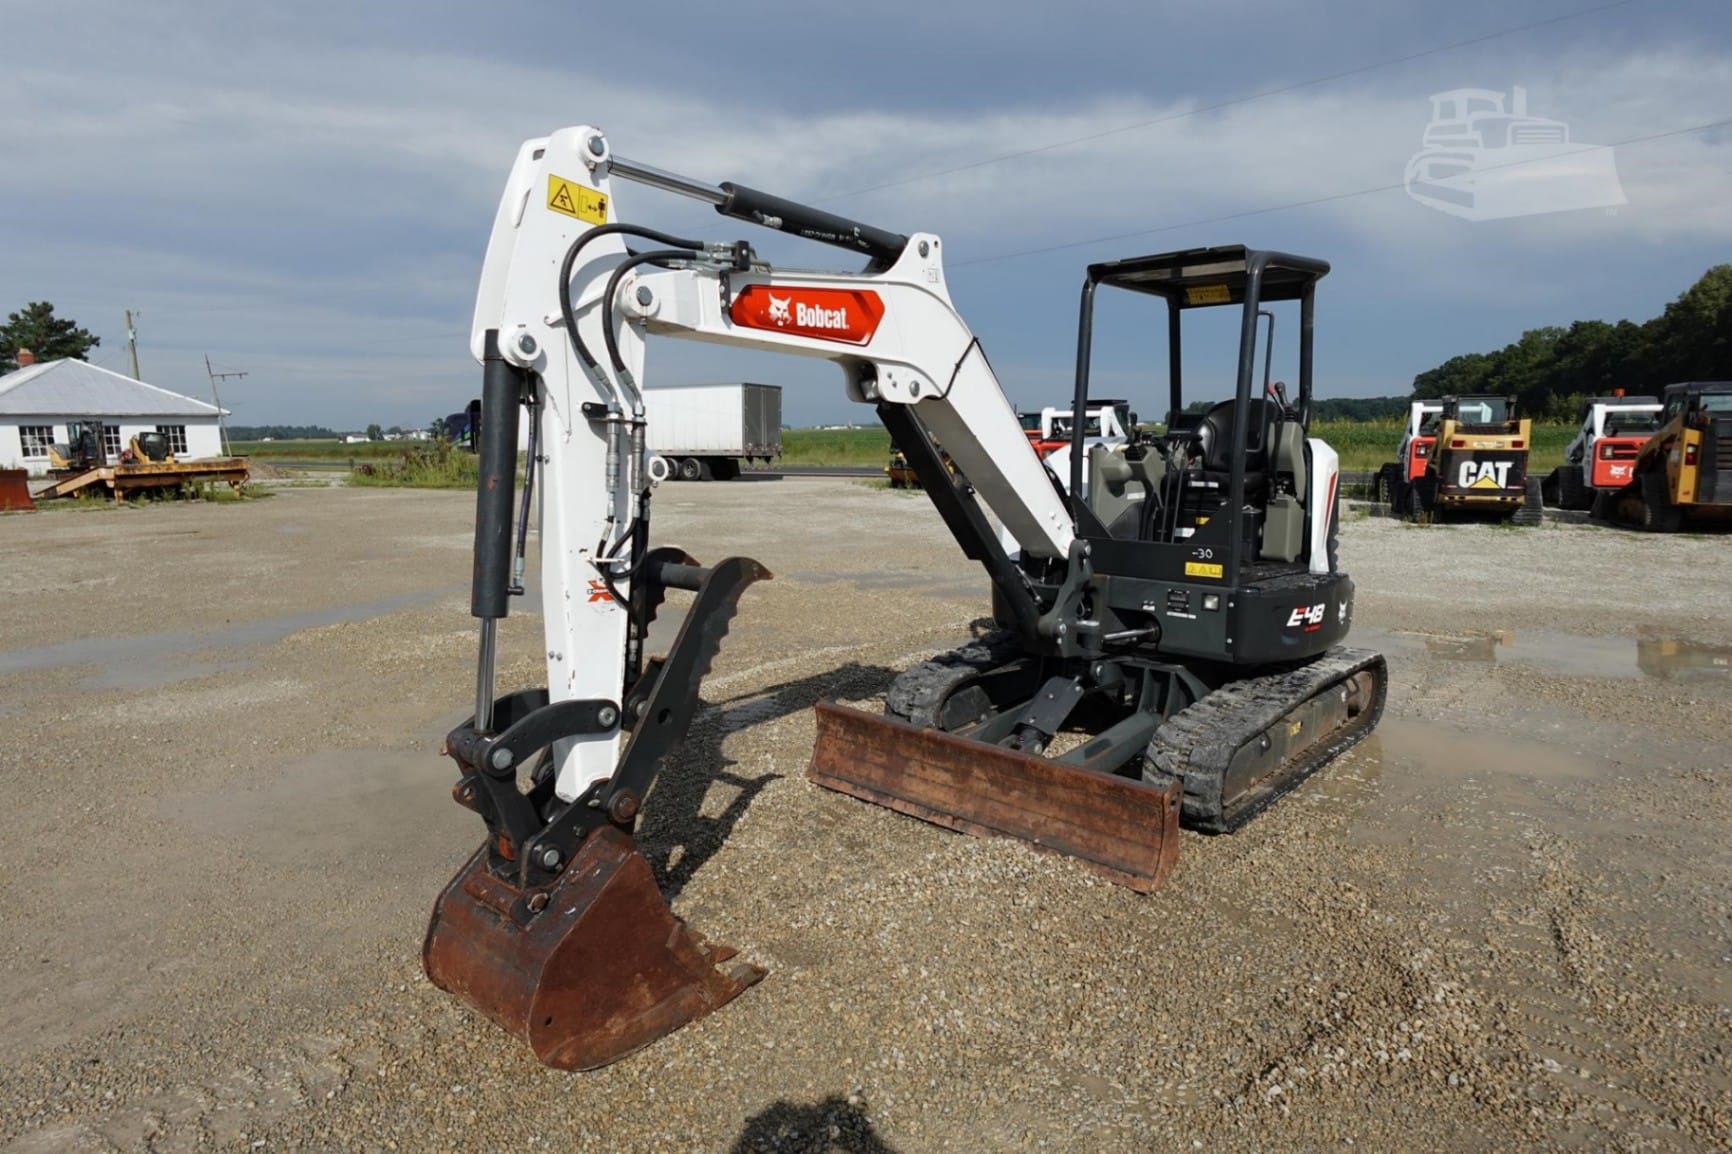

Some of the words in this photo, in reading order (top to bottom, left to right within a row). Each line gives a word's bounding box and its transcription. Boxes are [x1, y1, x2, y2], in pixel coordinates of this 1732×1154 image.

[796, 302, 848, 329] Bobcat
[1458, 460, 1514, 489] CAT
[1286, 603, 1326, 627] E48
